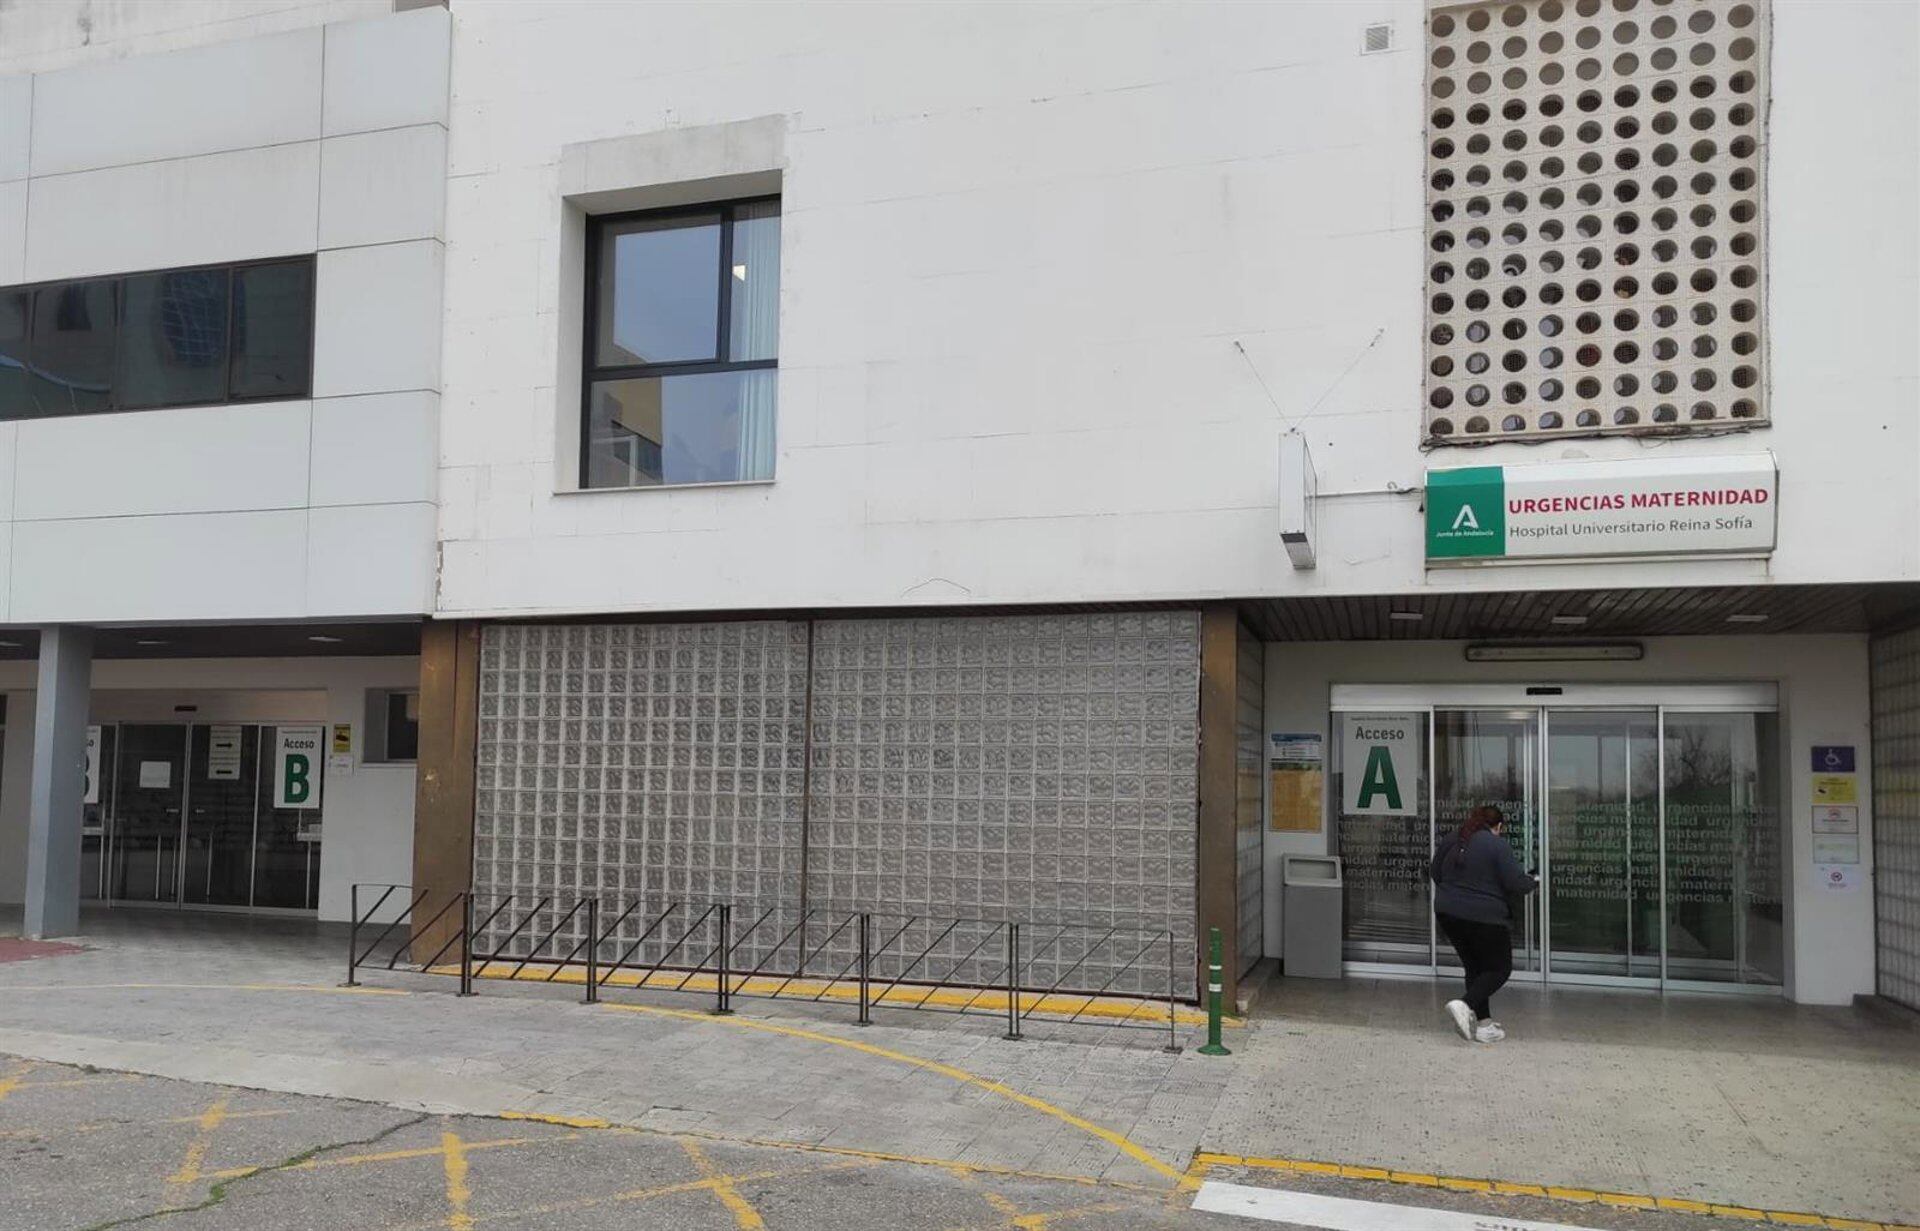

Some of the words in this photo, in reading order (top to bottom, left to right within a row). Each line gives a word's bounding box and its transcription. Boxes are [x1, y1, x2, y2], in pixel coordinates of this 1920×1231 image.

[1508, 494, 1625, 515] URGENCIAS
[1631, 487, 1769, 509] MATERNIDAD
[1509, 522, 1568, 539] Hospital
[1572, 519, 1666, 536] Universitario
[1669, 517, 1711, 532] Reina
[1715, 514, 1753, 531] Sofía
[1355, 725, 1405, 740] Acceso
[283, 737, 315, 750] Acceso
[283, 753, 310, 804] B
[1356, 745, 1403, 810] A
[1384, 858, 1430, 870] urgenc
[1552, 865, 1622, 876] urgencias
[1556, 889, 1638, 901] maternidad
